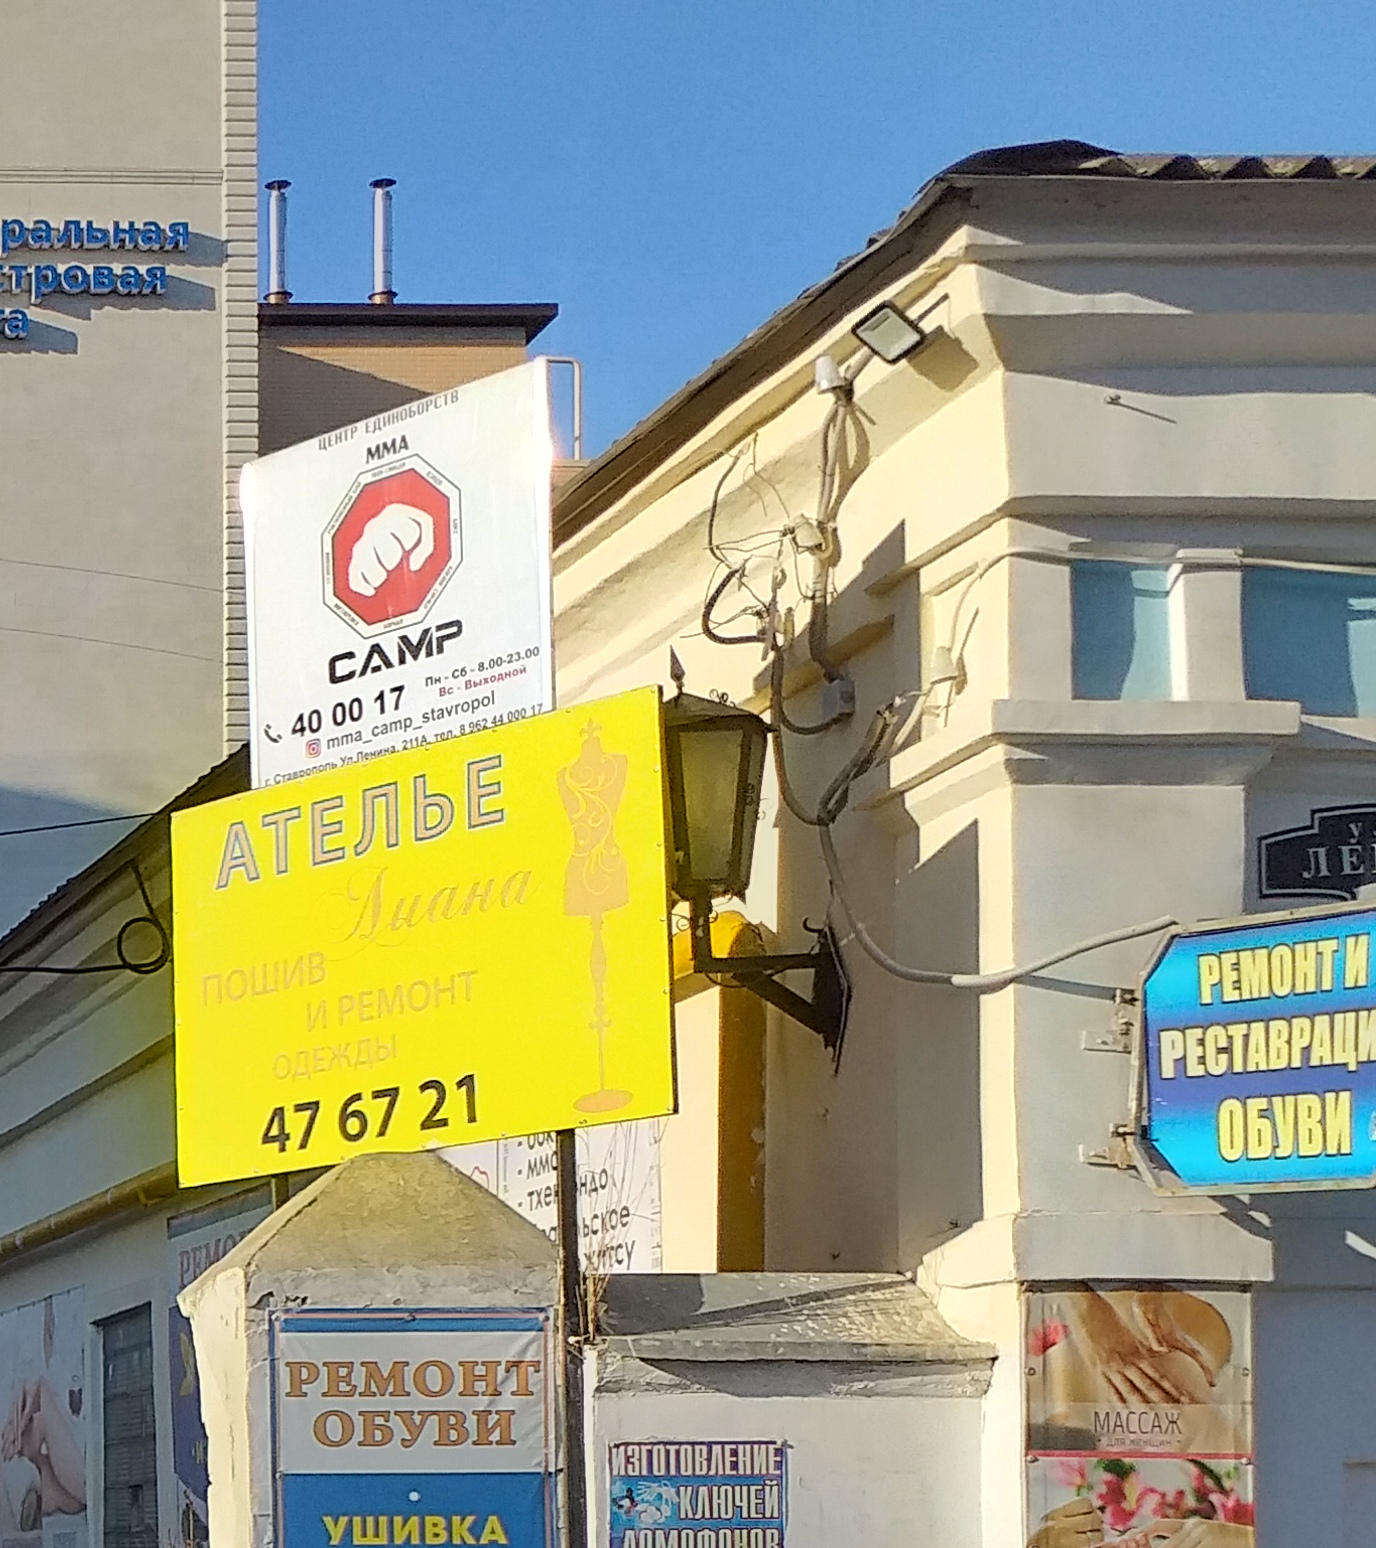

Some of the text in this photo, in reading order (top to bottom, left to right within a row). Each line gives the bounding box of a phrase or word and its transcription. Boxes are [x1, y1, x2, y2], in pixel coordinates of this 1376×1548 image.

[318, 389, 459, 451] ЦЕНТР ЕДИНОБОРСТВ
[328, 619, 463, 685] CAMP
[425, 675, 441, 687] Пн
[452, 666, 467, 680] Сб
[478, 646, 540, 672] 8.00-23.00
[439, 686, 454, 698] Вс
[465, 664, 527, 691] Выходной
[291, 685, 406, 737] 40 00 17
[326, 690, 495, 750] mma_camp_stavropol
[468, 718, 488, 733] 962
[491, 714, 504, 727] 44
[507, 707, 527, 723] 000
[531, 703, 543, 716] 17
[215, 754, 506, 890] АТЕЛЬЕ
[1348, 822, 1376, 843] у
[1302, 843, 1376, 878] ЛЕ
[201, 951, 327, 1007] ПОШИВ
[1198, 933, 1370, 1006] РЕМОНТ И
[306, 969, 479, 1032] И РЕМОНТ
[272, 1034, 398, 1082] ОДЕЖДЫ
[261, 1074, 479, 1154] 47 67 21
[1218, 1090, 1353, 1162] ОБУВИ
[285, 1360, 541, 1398] РЕМОНТ
[313, 1409, 518, 1449] ОБУВИ
[1094, 1411, 1183, 1435] МАССАЖ
[612, 1444, 782, 1476] ИЗГОТОВЛЕНИЕ
[678, 1479, 779, 1519] КЛЮЧЕЙ
[322, 1515, 509, 1546] УШИВКА
